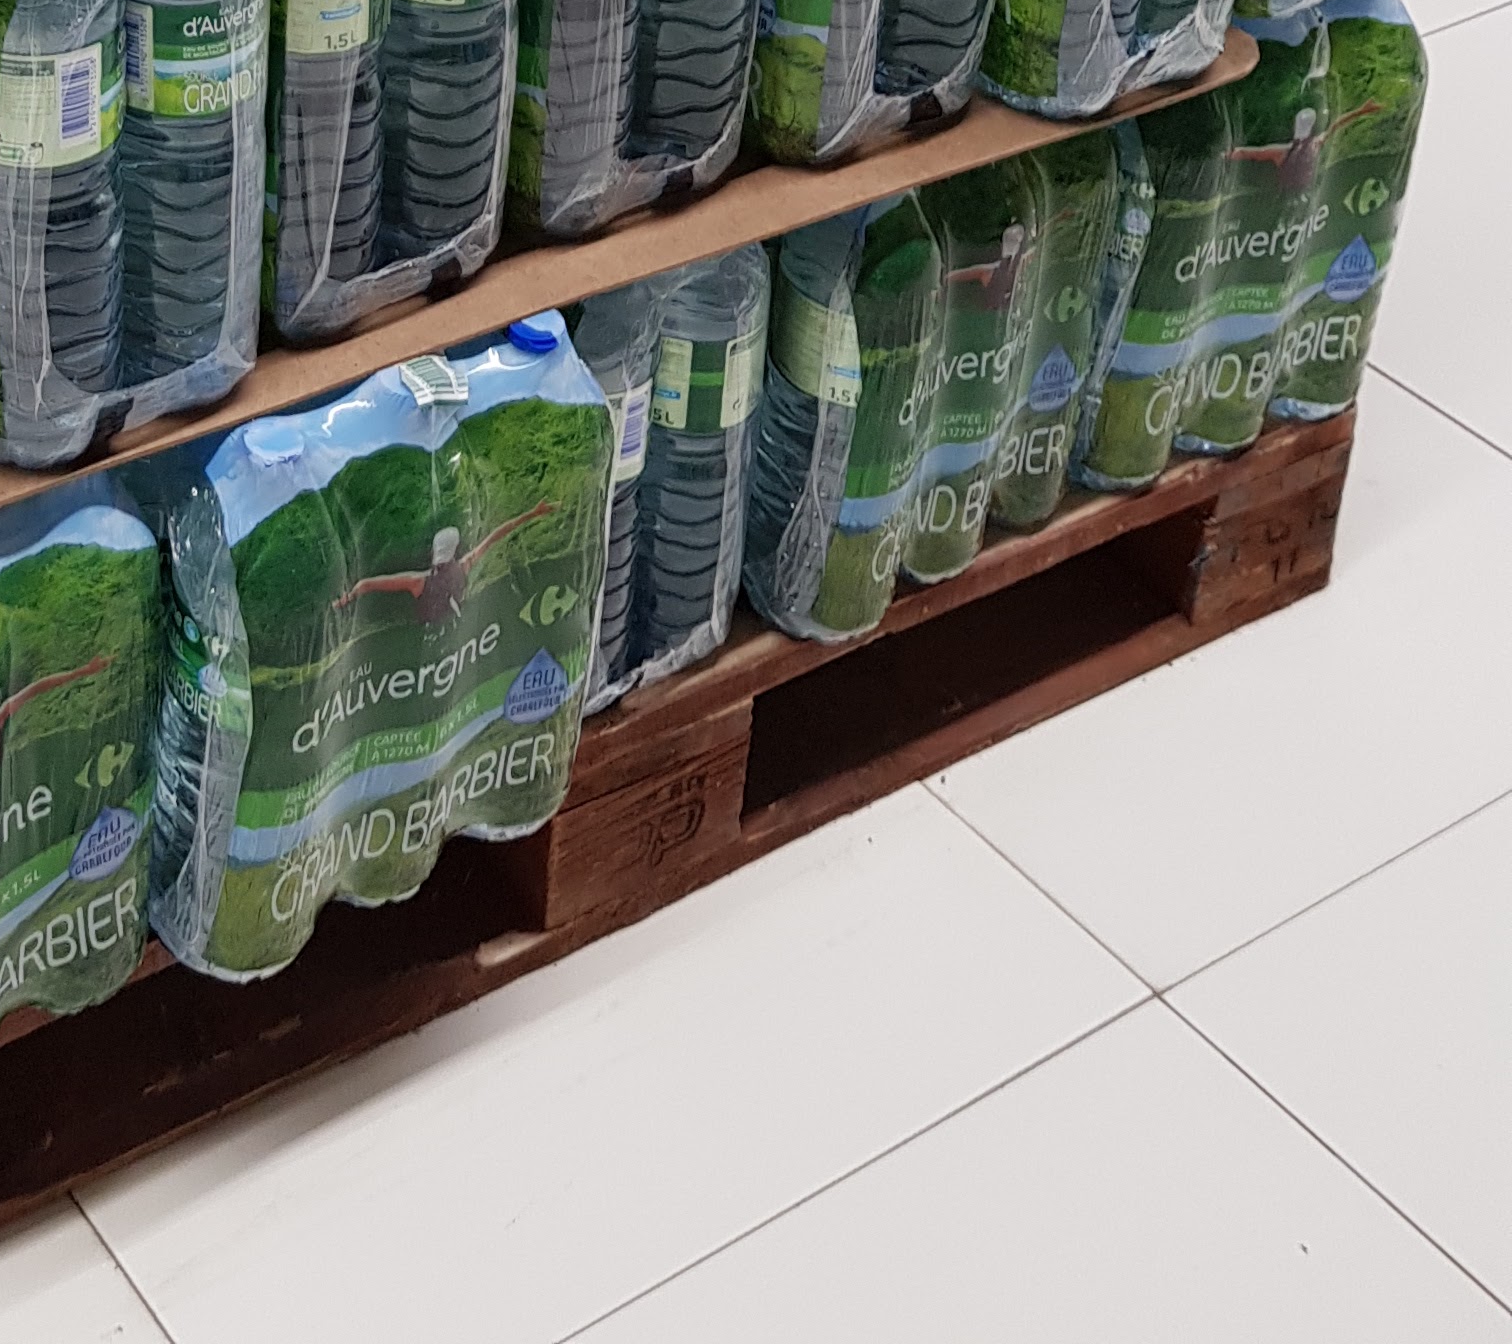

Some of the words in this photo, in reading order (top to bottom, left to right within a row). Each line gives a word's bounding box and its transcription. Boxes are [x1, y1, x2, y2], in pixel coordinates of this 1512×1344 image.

[1175, 204, 1331, 284] d'Auvergne
[1341, 251, 1368, 272] EAU
[292, 623, 500, 753] d'Auvergne
[349, 662, 373, 684] EAU
[523, 666, 557, 691] EAU
[88, 816, 122, 848] EAU
[272, 808, 396, 923] GRAND
[402, 733, 555, 855] BARBIER
